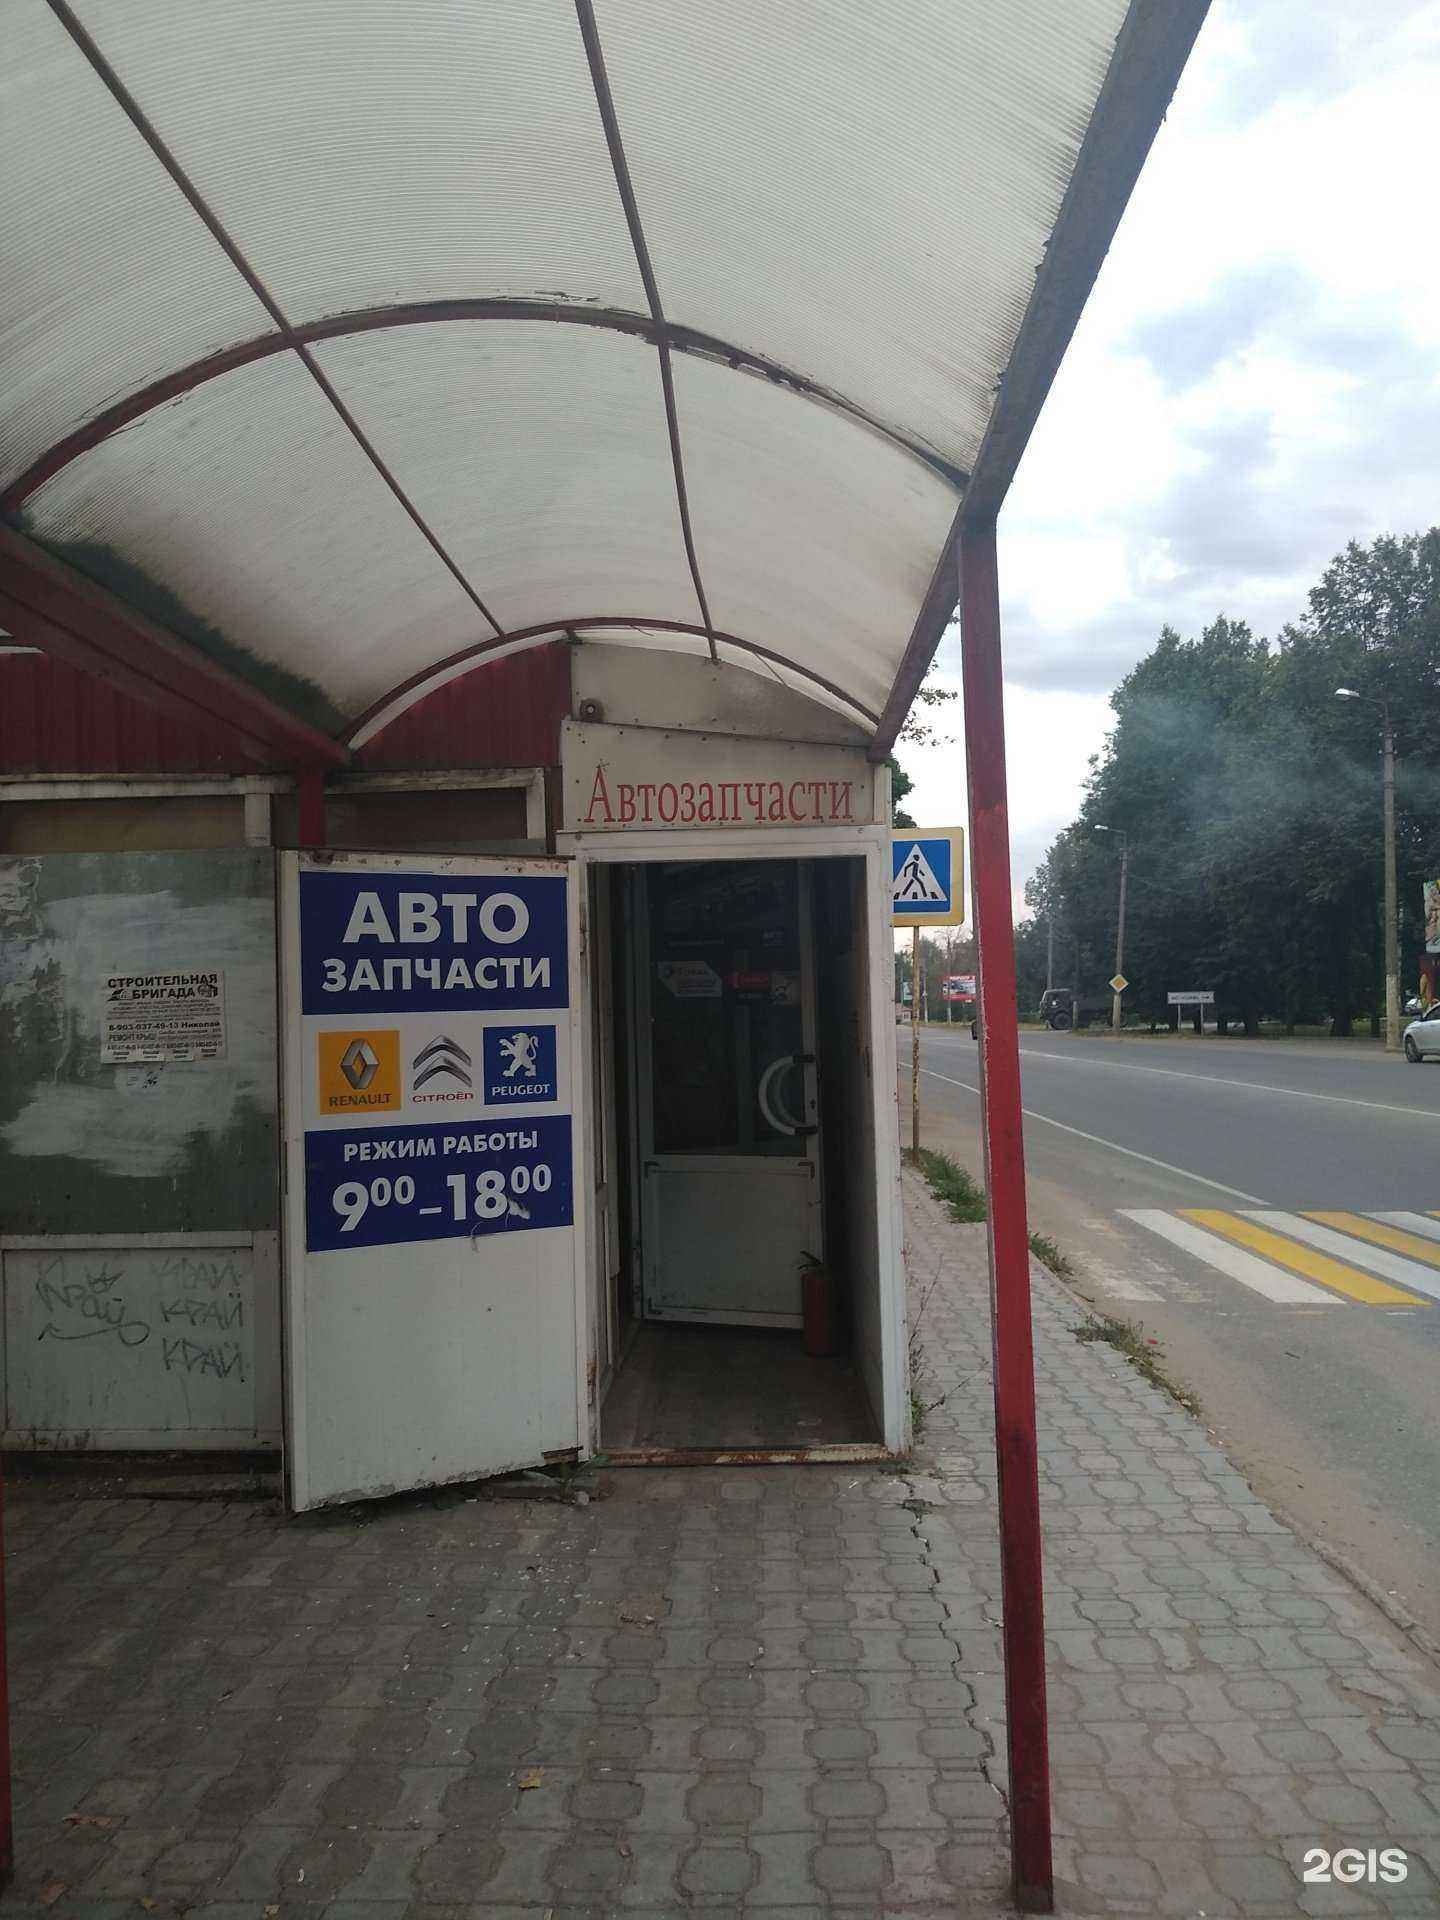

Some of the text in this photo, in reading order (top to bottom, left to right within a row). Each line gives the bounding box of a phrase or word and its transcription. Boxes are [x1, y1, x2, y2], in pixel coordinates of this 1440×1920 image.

[584, 767, 854, 823] Автозапчасти
[342, 891, 531, 945] АВТО
[107, 973, 218, 988] СТРОИТЕЛЬНАЯ
[321, 956, 552, 993] ЗАПЧАСТИ
[132, 988, 196, 999] БРИГАДА
[328, 1093, 393, 1107] RENAULT
[491, 1083, 552, 1097] PEUGEOT
[343, 1130, 538, 1162] РЕЖИМ РАБОТЫ
